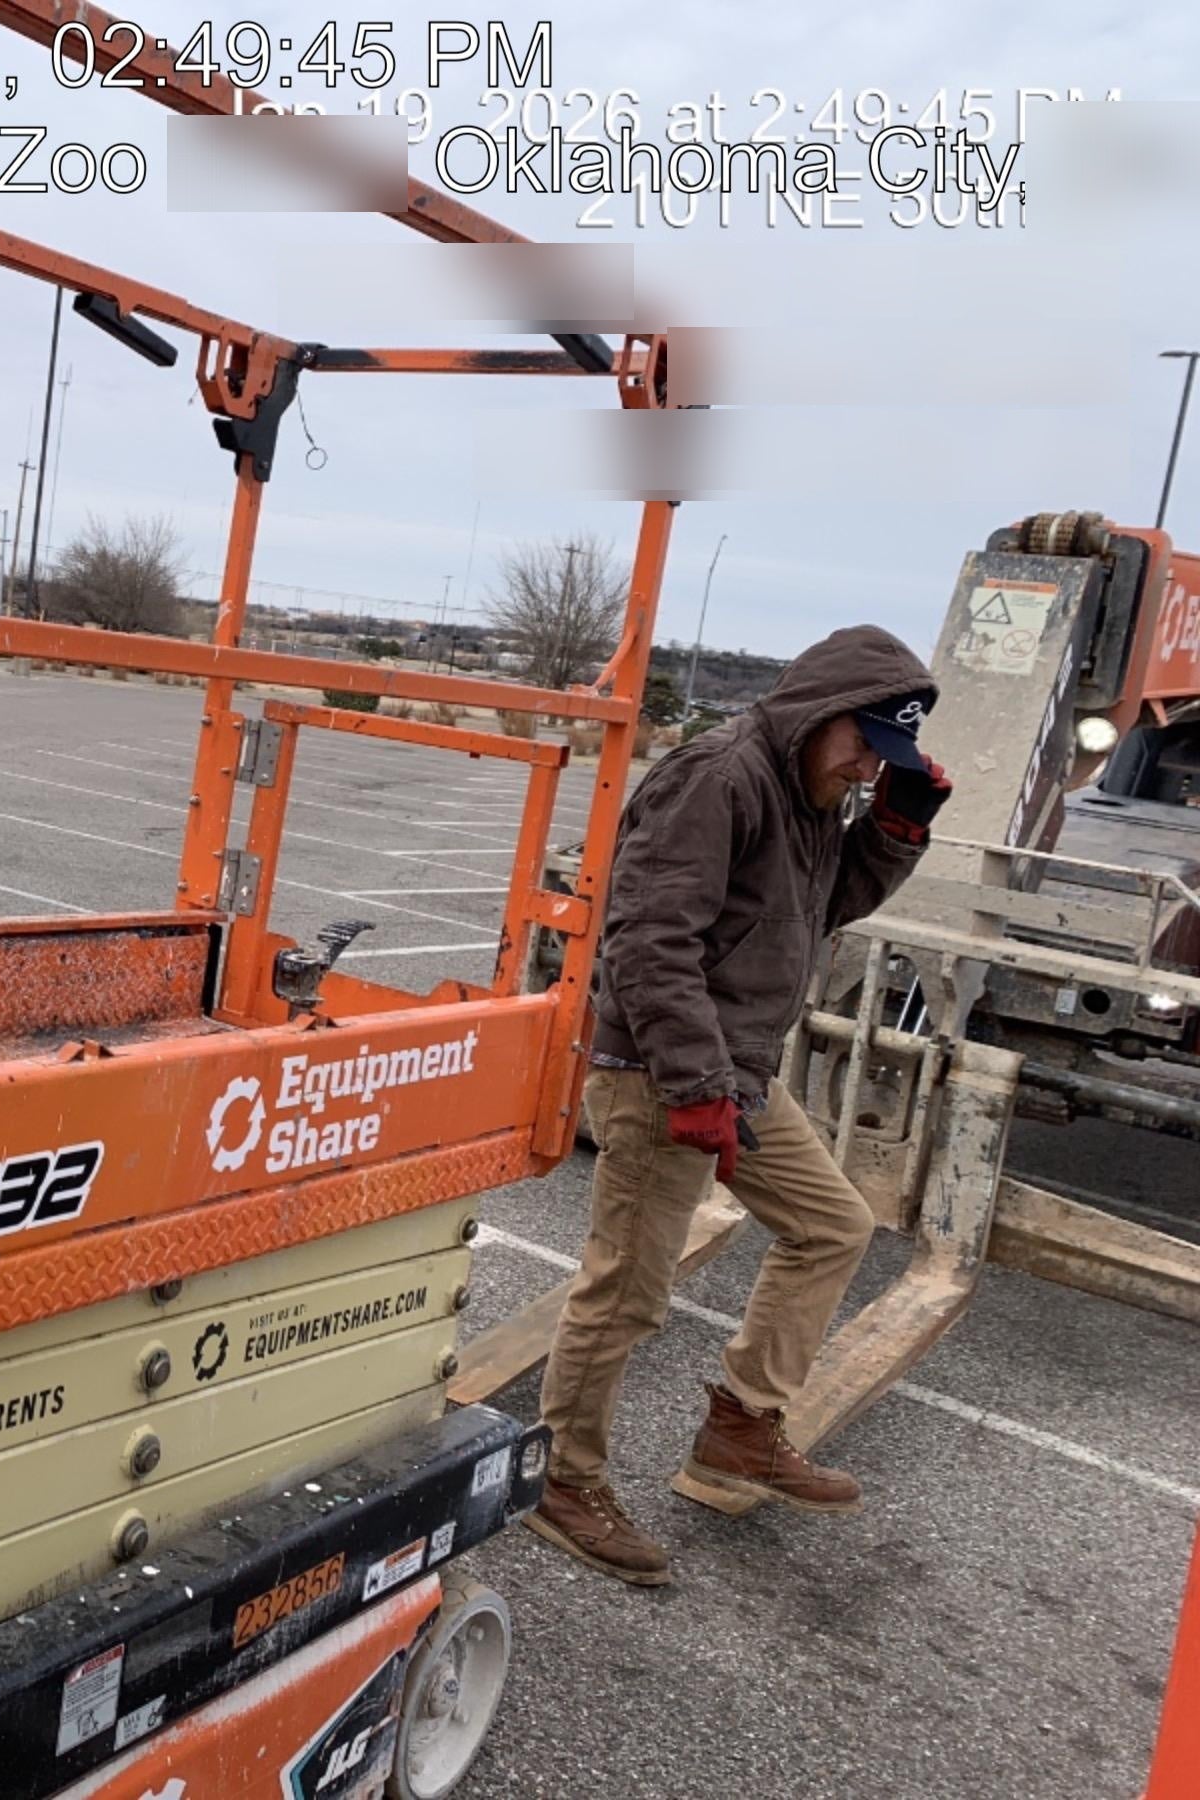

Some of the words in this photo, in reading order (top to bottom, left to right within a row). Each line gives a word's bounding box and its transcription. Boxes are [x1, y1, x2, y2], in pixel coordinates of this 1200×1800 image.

[275, 1029, 480, 1114] Equipment
[265, 1112, 382, 1173] Share
[243, 1286, 428, 1363] EQUIPMENTSHARE.COM
[236, 1555, 343, 1645] 232856
[315, 1725, 374, 1792] JLG
